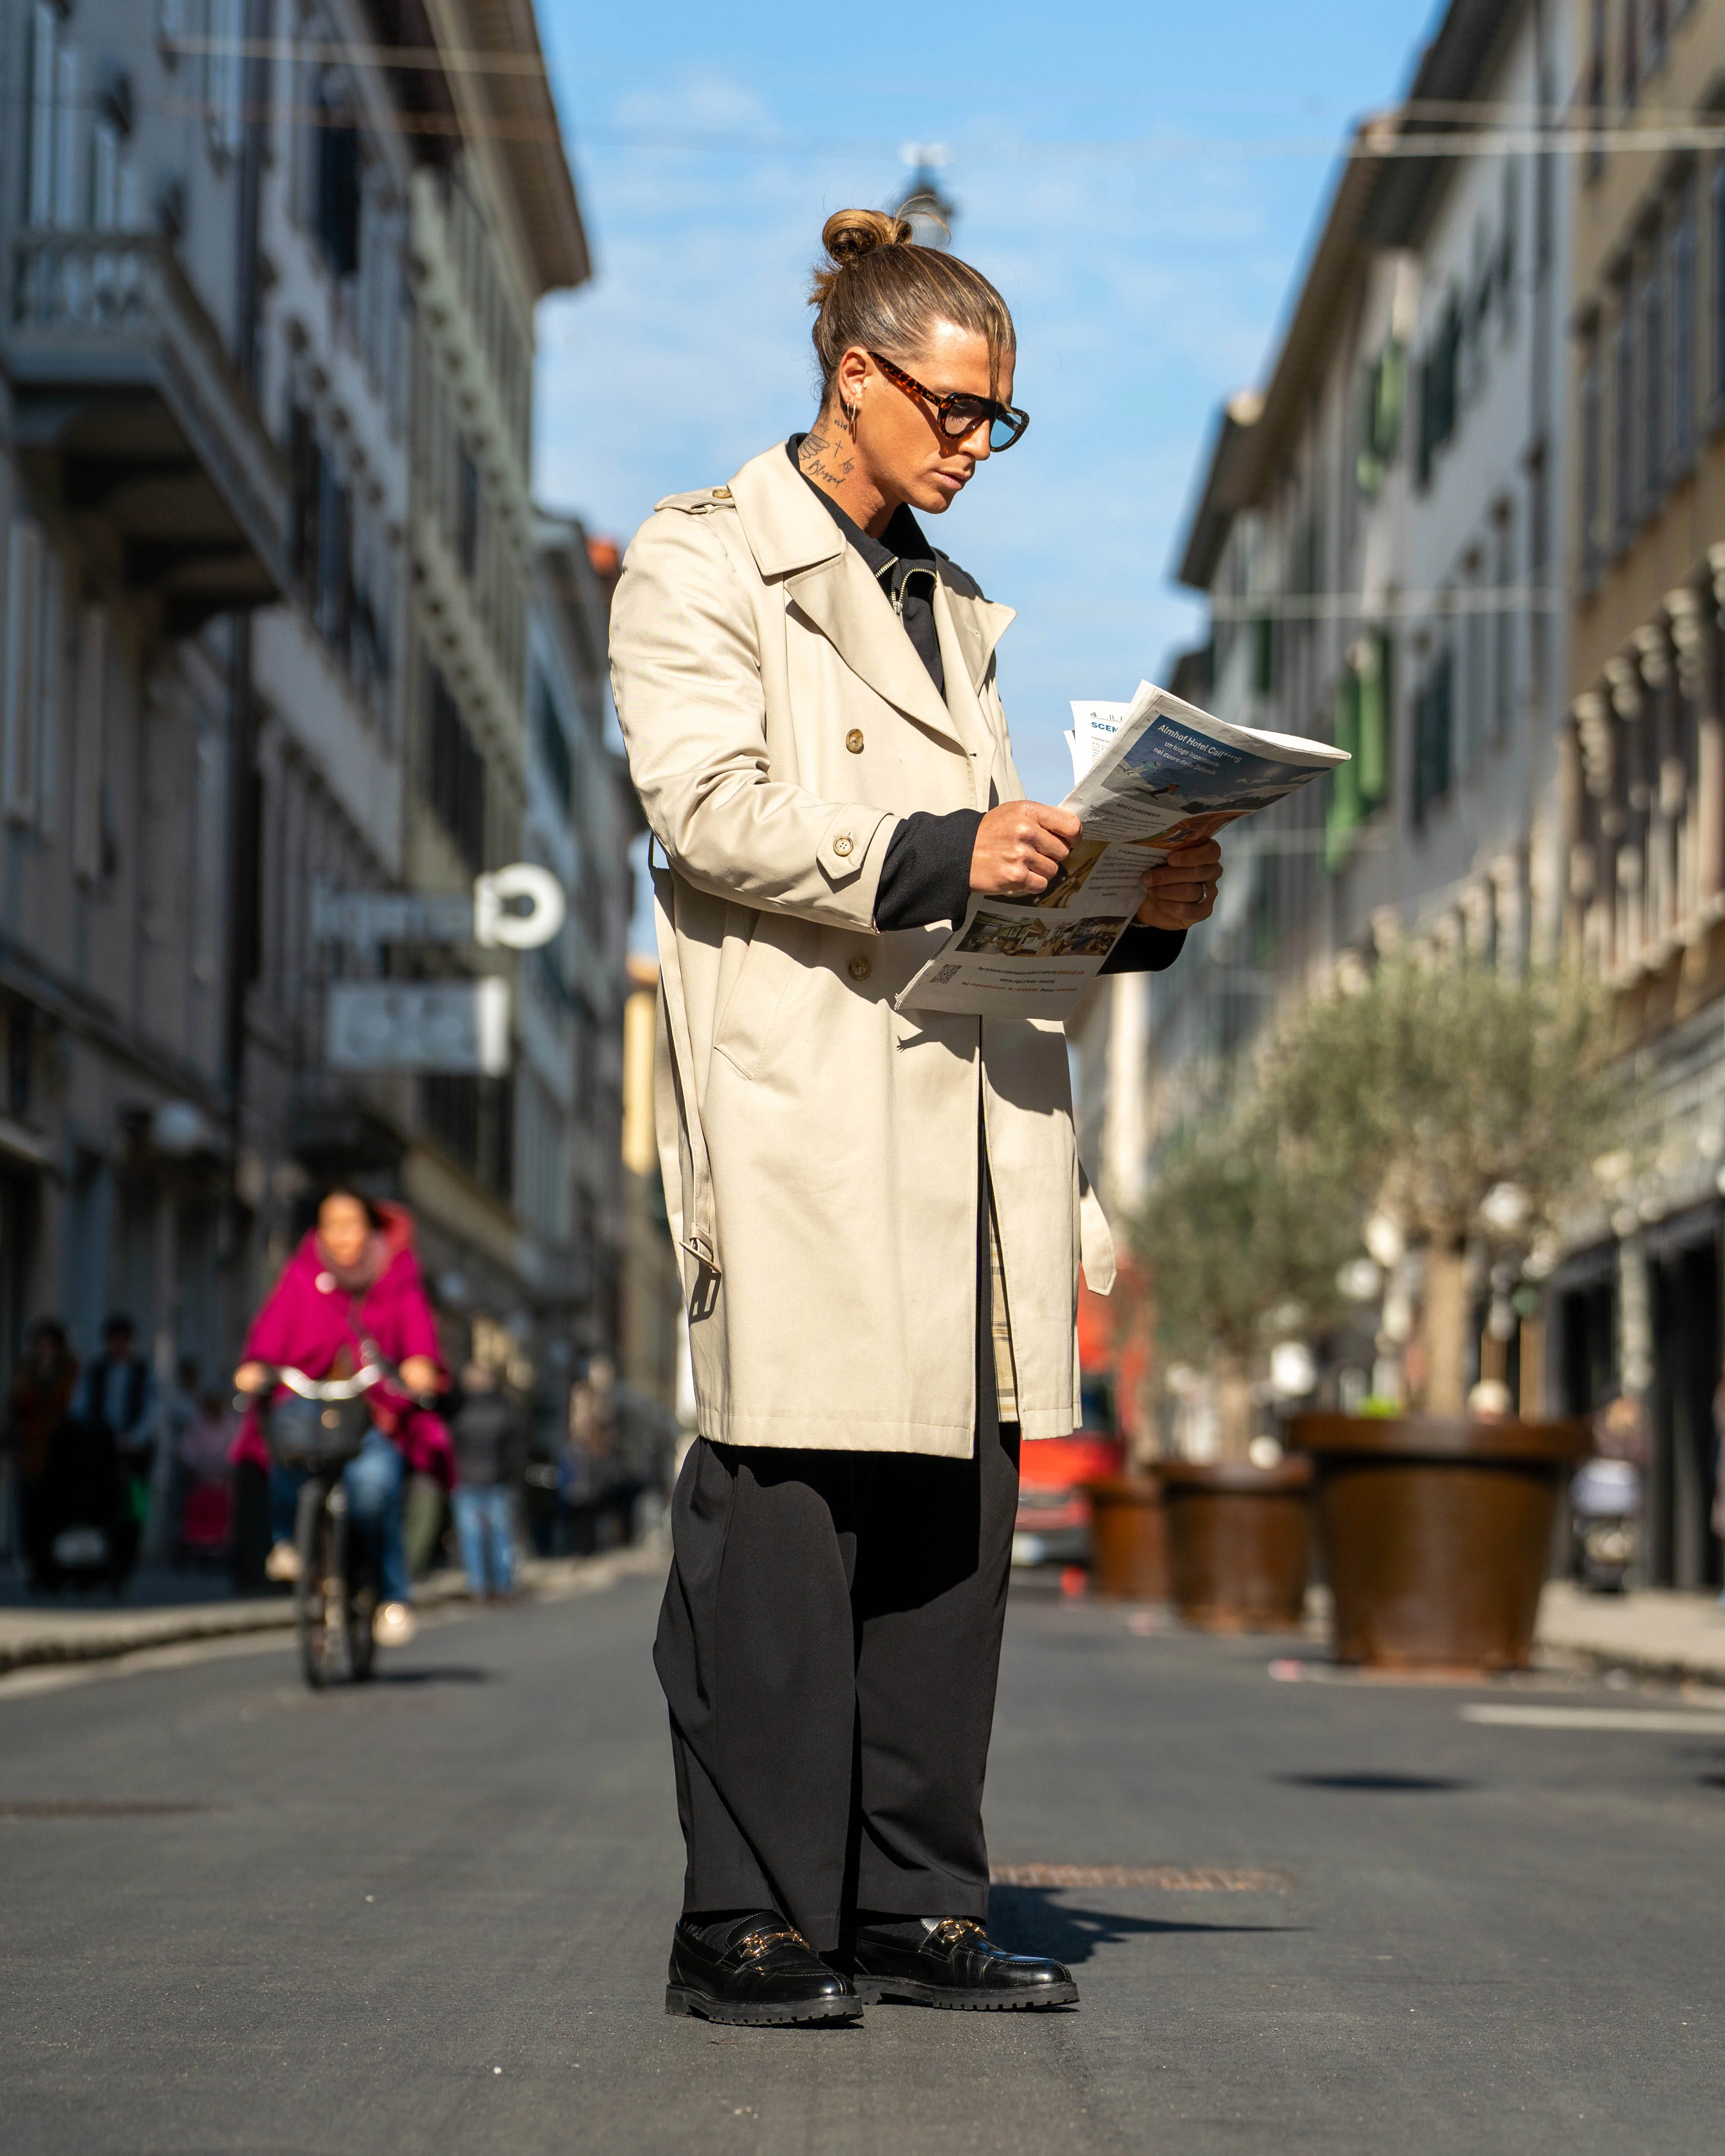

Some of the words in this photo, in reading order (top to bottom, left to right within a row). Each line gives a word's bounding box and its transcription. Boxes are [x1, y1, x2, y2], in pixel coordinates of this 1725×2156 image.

[1158, 724, 1188, 742] Almhof
[1187, 737, 1209, 752] Hotel
[1164, 753, 1179, 763] cuore
[1180, 759, 1194, 768] delle
[1194, 765, 1217, 776] Dolomiti
[1173, 744, 1189, 755] luogo
[1189, 752, 1220, 768] incantevole
